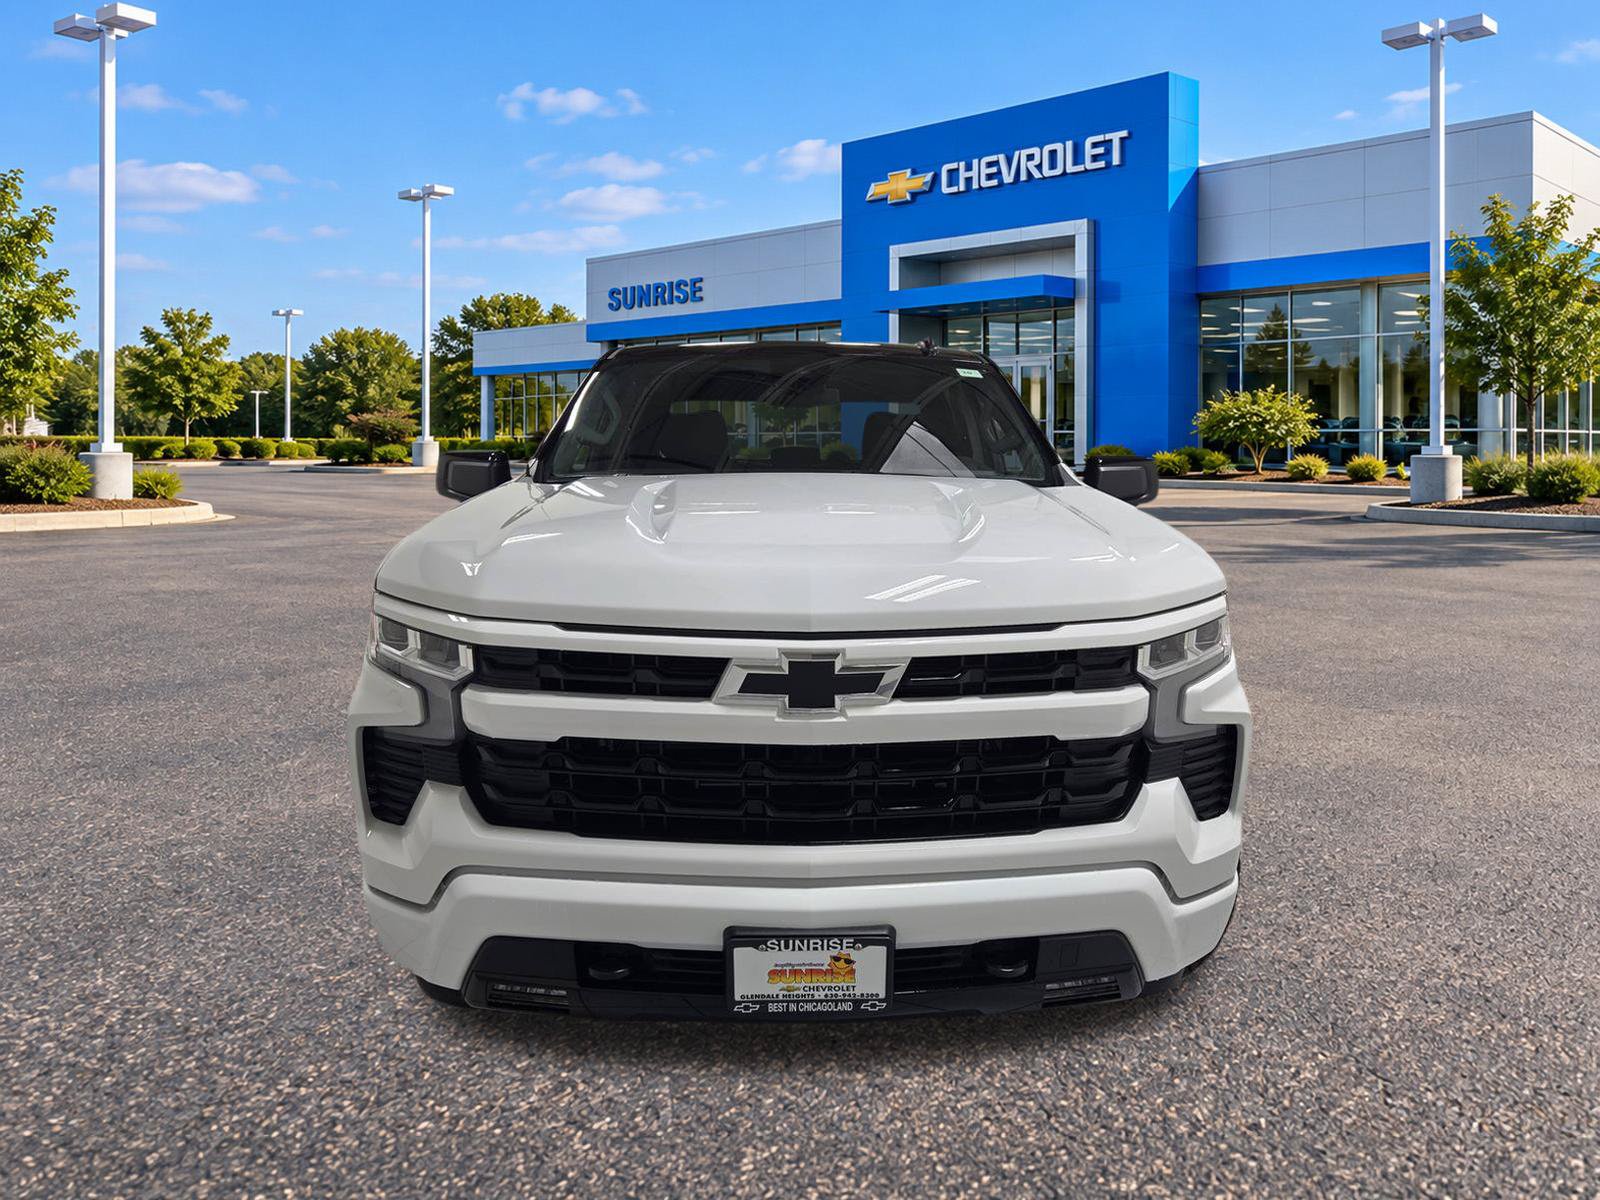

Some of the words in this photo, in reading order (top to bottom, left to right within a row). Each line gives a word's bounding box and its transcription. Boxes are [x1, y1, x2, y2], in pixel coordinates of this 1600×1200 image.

[941, 130, 1129, 195] CHEVROLET
[607, 277, 704, 312] SUNRISE
[766, 938, 855, 952] SUNRISE
[767, 968, 856, 985] SUNRISE
[802, 985, 857, 993] CHEVROLET
[768, 1002, 788, 1012] BEST
[789, 1002, 797, 1012] IN
[798, 1002, 853, 1012] CHICAGOLAND
